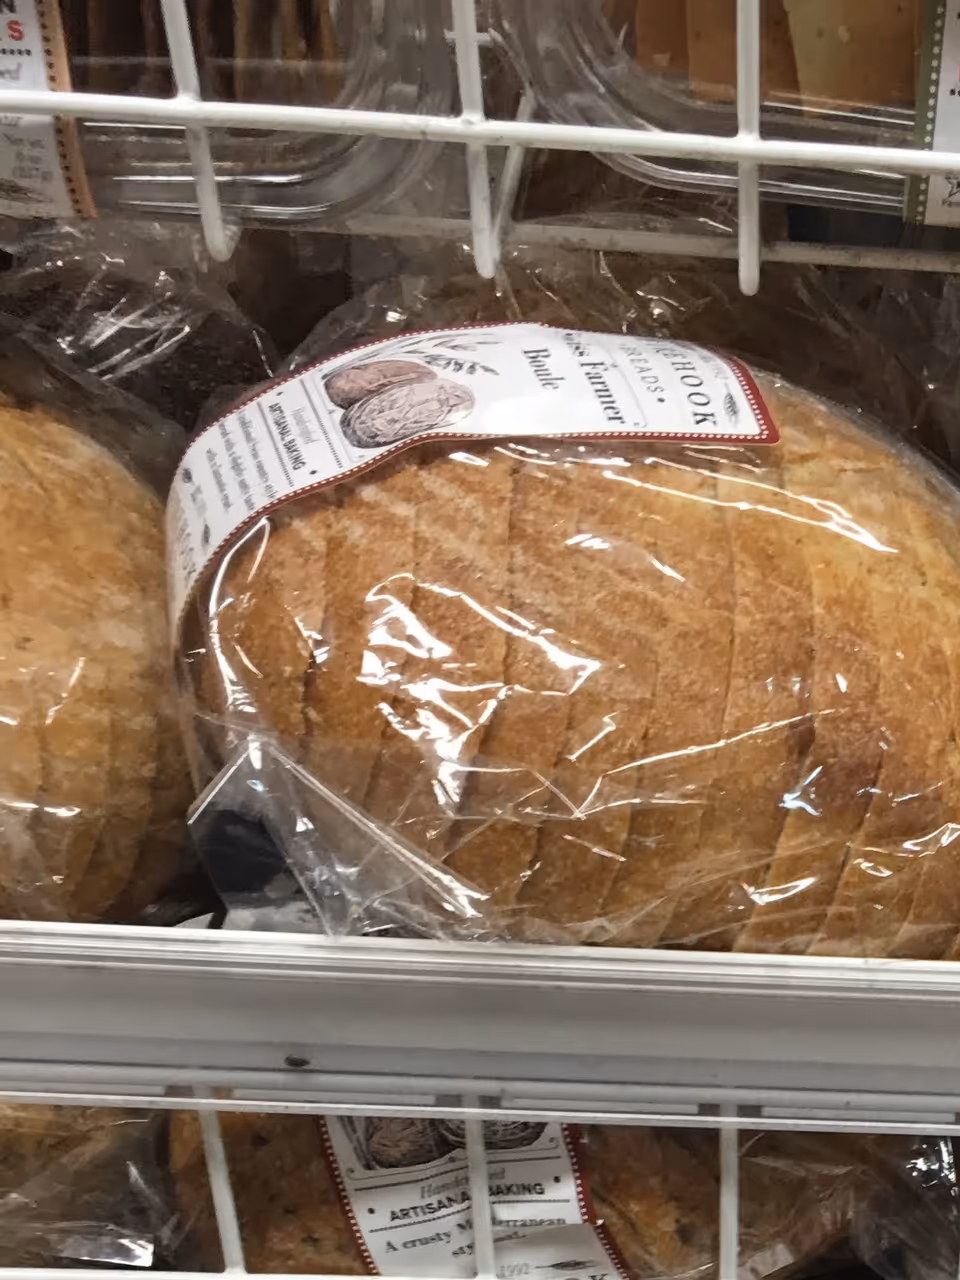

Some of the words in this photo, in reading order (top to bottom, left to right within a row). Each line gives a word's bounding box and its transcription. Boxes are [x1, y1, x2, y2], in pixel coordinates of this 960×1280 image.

[523, 347, 565, 390] Boule
[579, 360, 626, 425] Farmer
[384, 1241, 399, 1254] A
[401, 1229, 453, 1251] crusty
